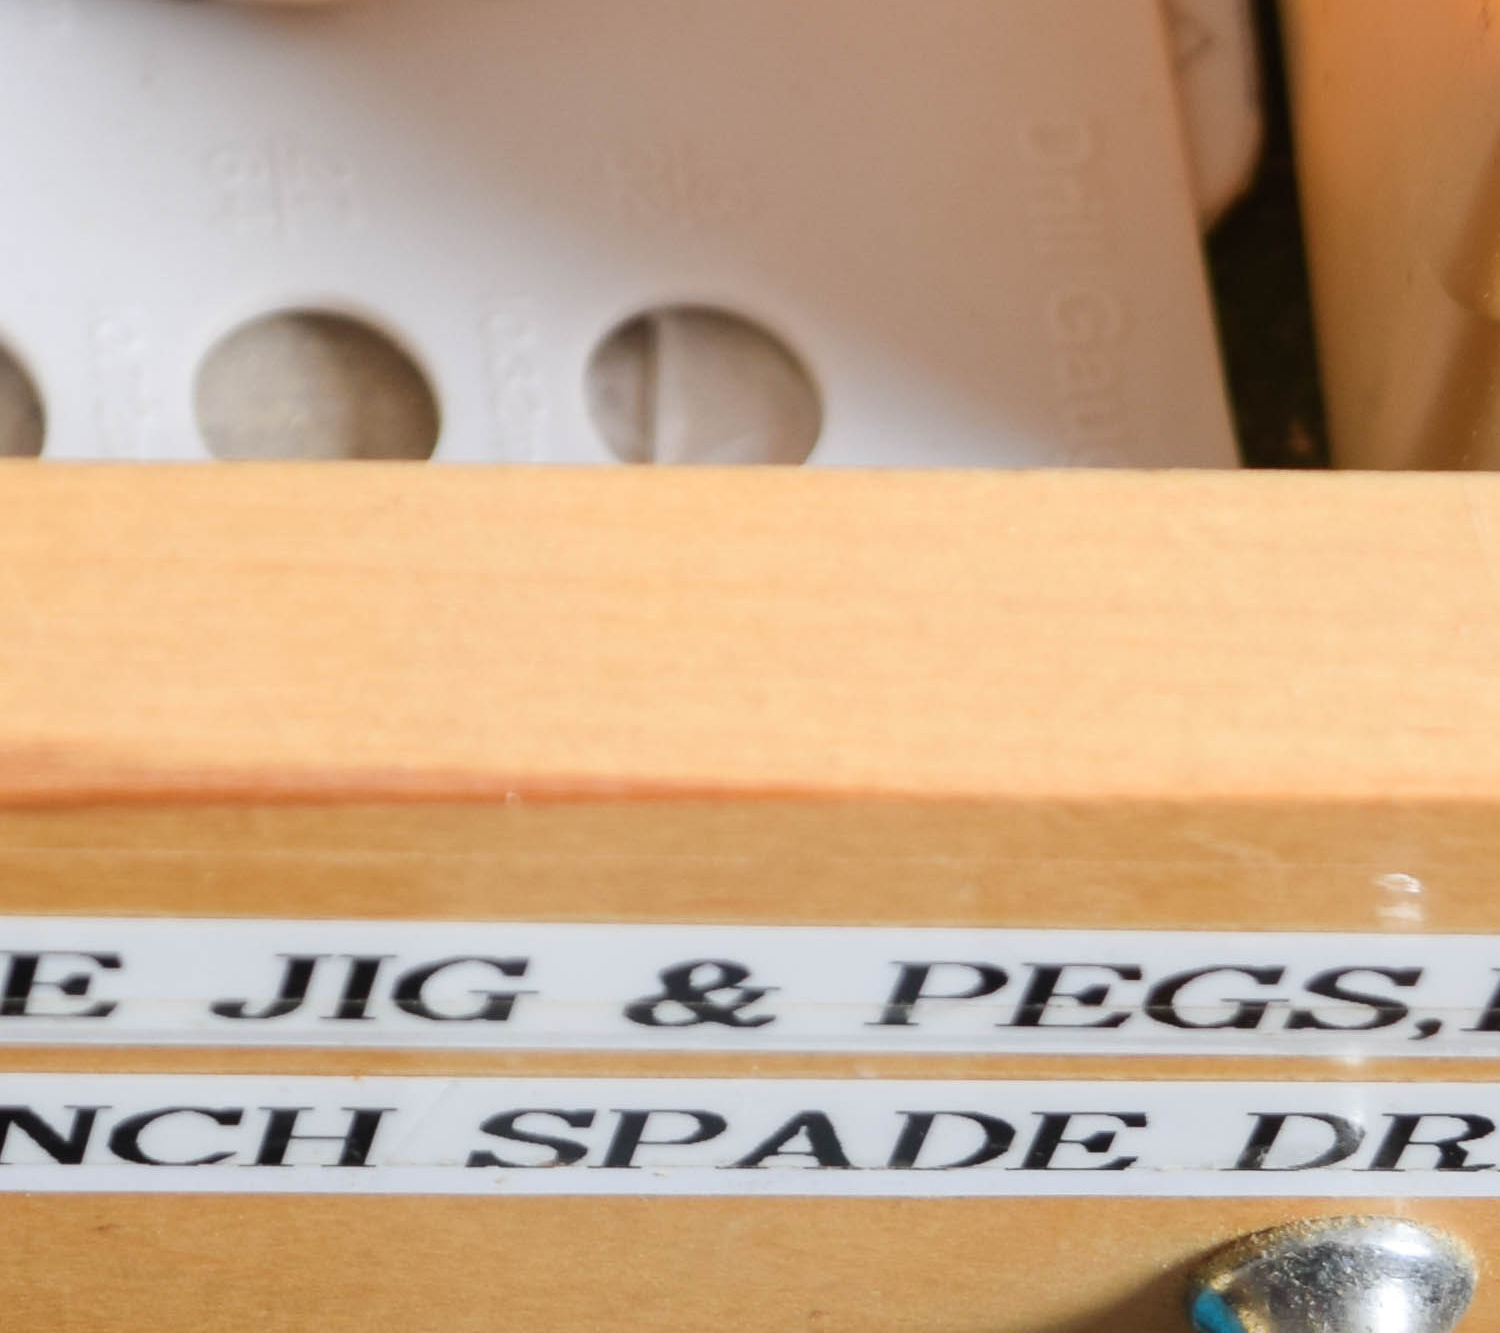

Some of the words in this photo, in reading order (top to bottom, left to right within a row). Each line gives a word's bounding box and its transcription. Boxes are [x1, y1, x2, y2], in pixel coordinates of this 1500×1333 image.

[210, 953, 537, 1023] JIG
[624, 958, 777, 1029] &
[466, 1109, 1149, 1172] SPADE
